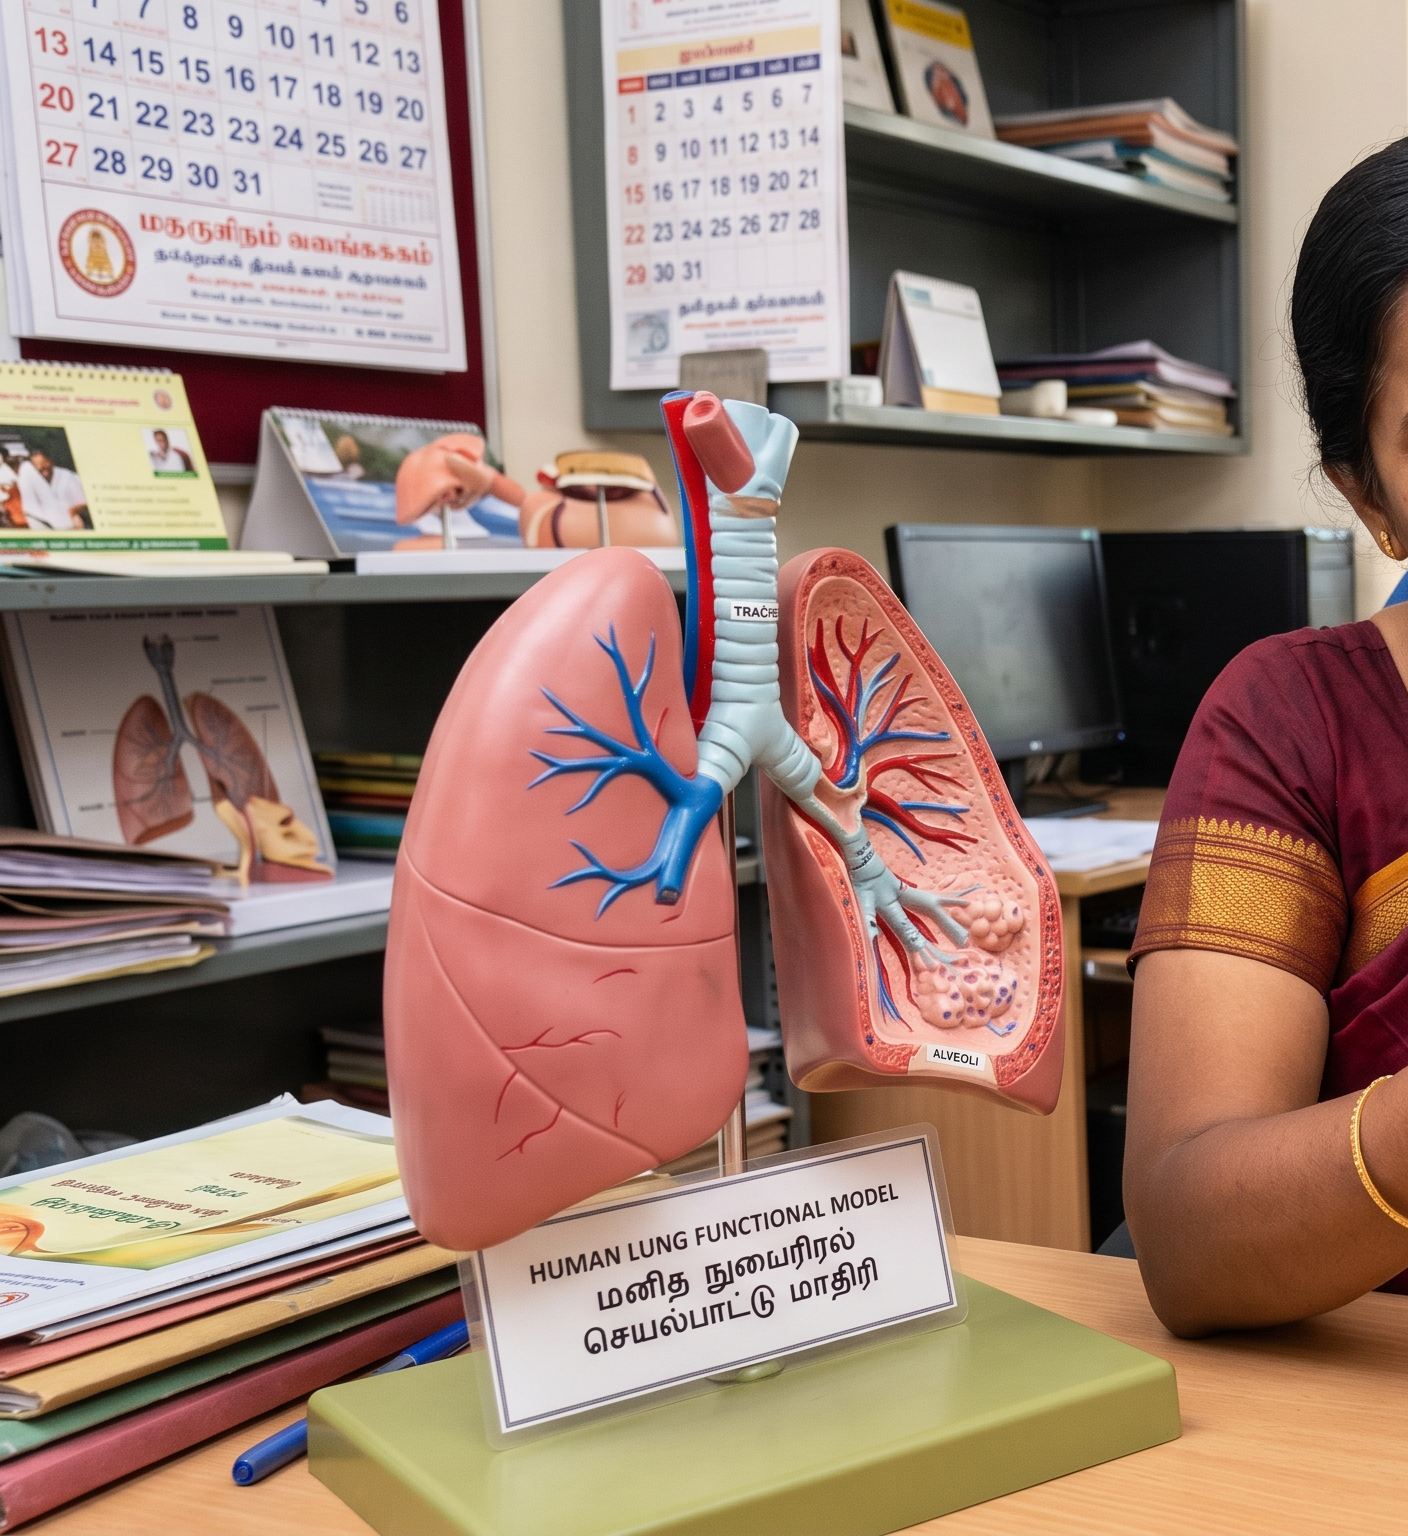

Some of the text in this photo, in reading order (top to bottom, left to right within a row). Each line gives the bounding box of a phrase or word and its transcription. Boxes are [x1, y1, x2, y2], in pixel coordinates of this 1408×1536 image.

[394, 0, 409, 24] 6
[183, 4, 199, 30] 8
[227, 14, 244, 39] 9
[265, 23, 295, 50] 10
[309, 32, 334, 58] 11
[351, 40, 380, 67] 12
[393, 48, 421, 75] 13
[34, 27, 424, 122] 13 14 15 15 16 17 18 19 20
[627, 83, 812, 124] 1 2 3 4 5 6 7
[39, 82, 428, 169] 20 21 22 23 23 24 25 26 27
[627, 126, 820, 165] 8 9 10 11 12 13 14
[45, 139, 261, 196] 27 28 29 30 31
[624, 168, 818, 205] 15 16 17 18 19 20 21
[624, 208, 821, 246] 22 23 24 25 26 27 28
[626, 260, 702, 286] 29 30 31
[933, 1049, 979, 1066] ALVEOLI
[529, 1182, 900, 1285] HUMAN LUNG FUNCTIONAL MODEL
[583, 1256, 880, 1355] செயல்பாட்டு மாதிரி
[596, 1268, 691, 1312] மனித
